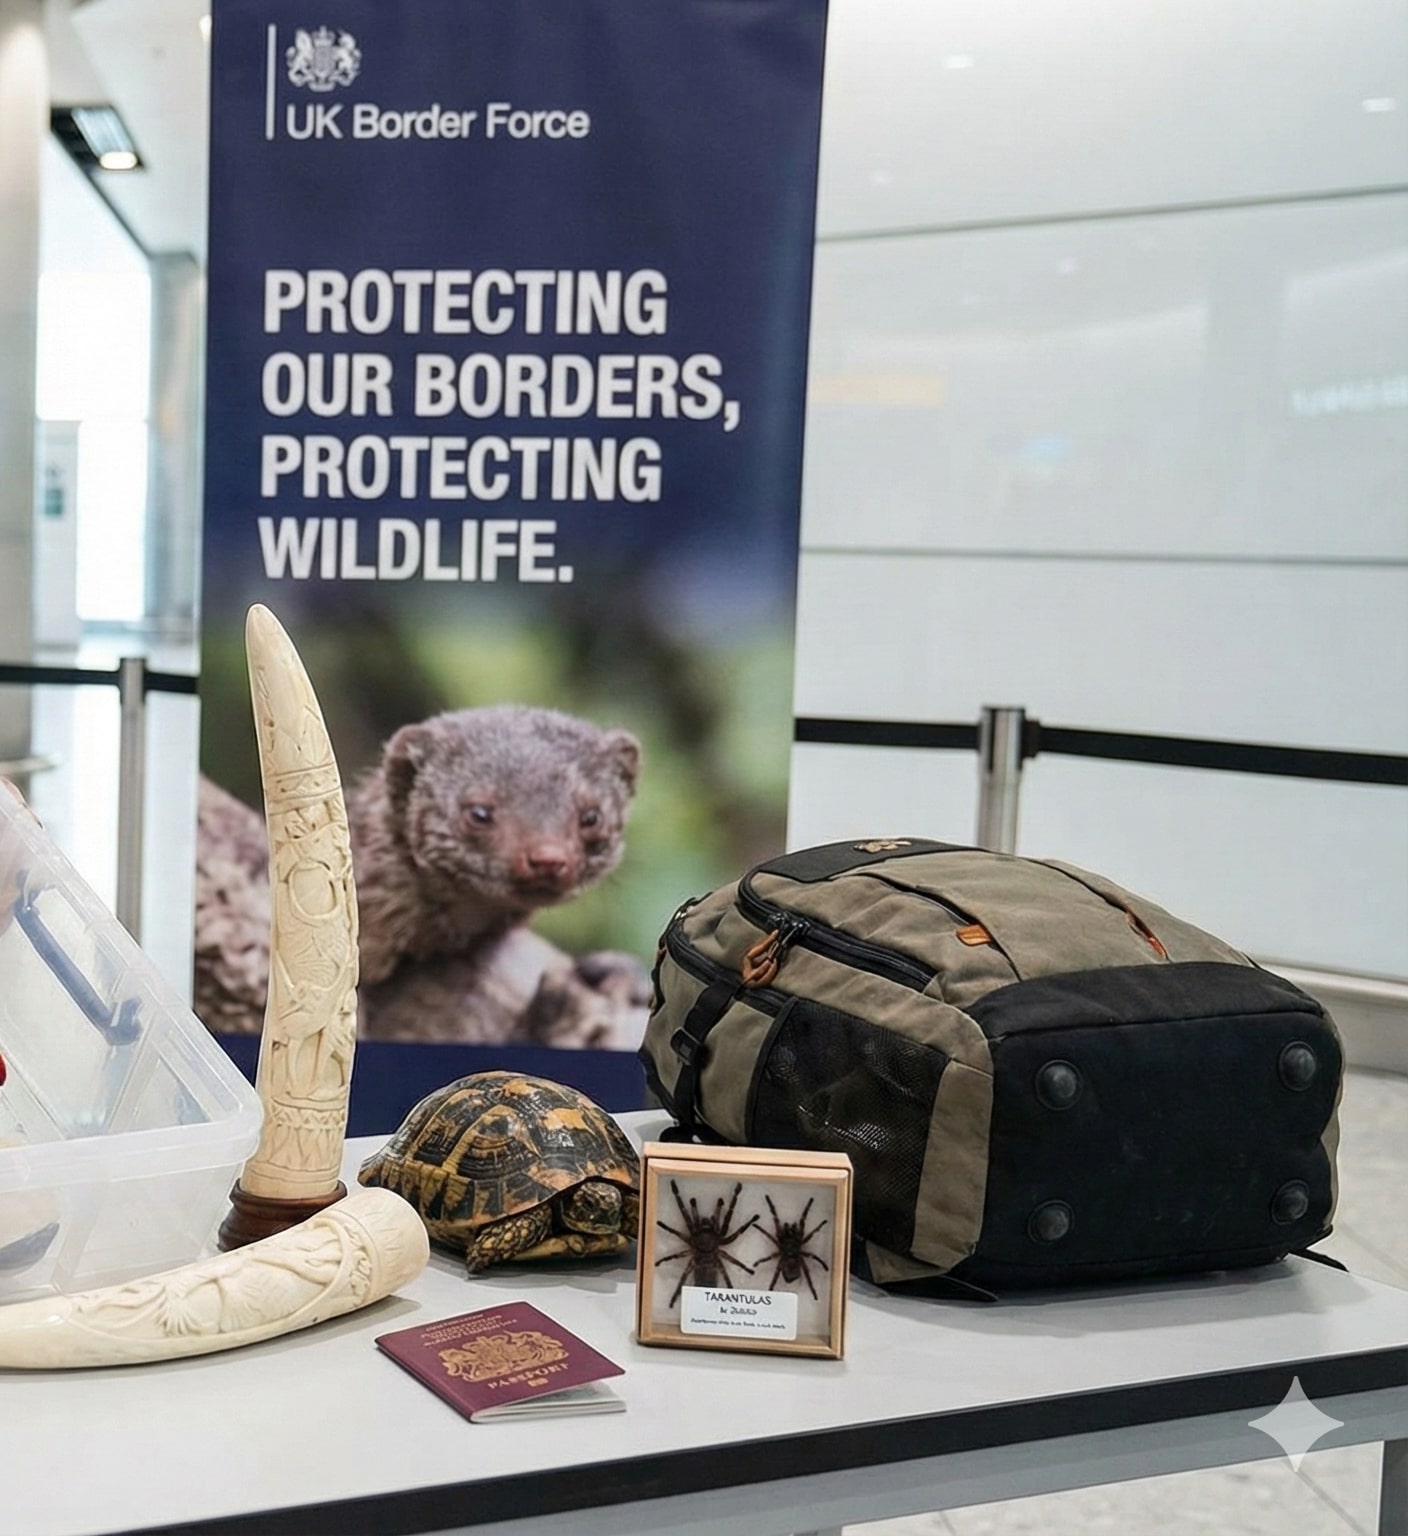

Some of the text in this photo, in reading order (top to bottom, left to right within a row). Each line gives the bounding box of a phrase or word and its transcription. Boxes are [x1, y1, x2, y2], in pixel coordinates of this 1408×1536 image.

[287, 102, 590, 140] UK Border Force
[264, 269, 667, 335] PROTECTING
[262, 352, 740, 432] OUR BORDERS,
[261, 435, 662, 502] PROTECTING
[258, 517, 574, 583] WILDLIFE.
[704, 1291, 773, 1306] TARANTULAS
